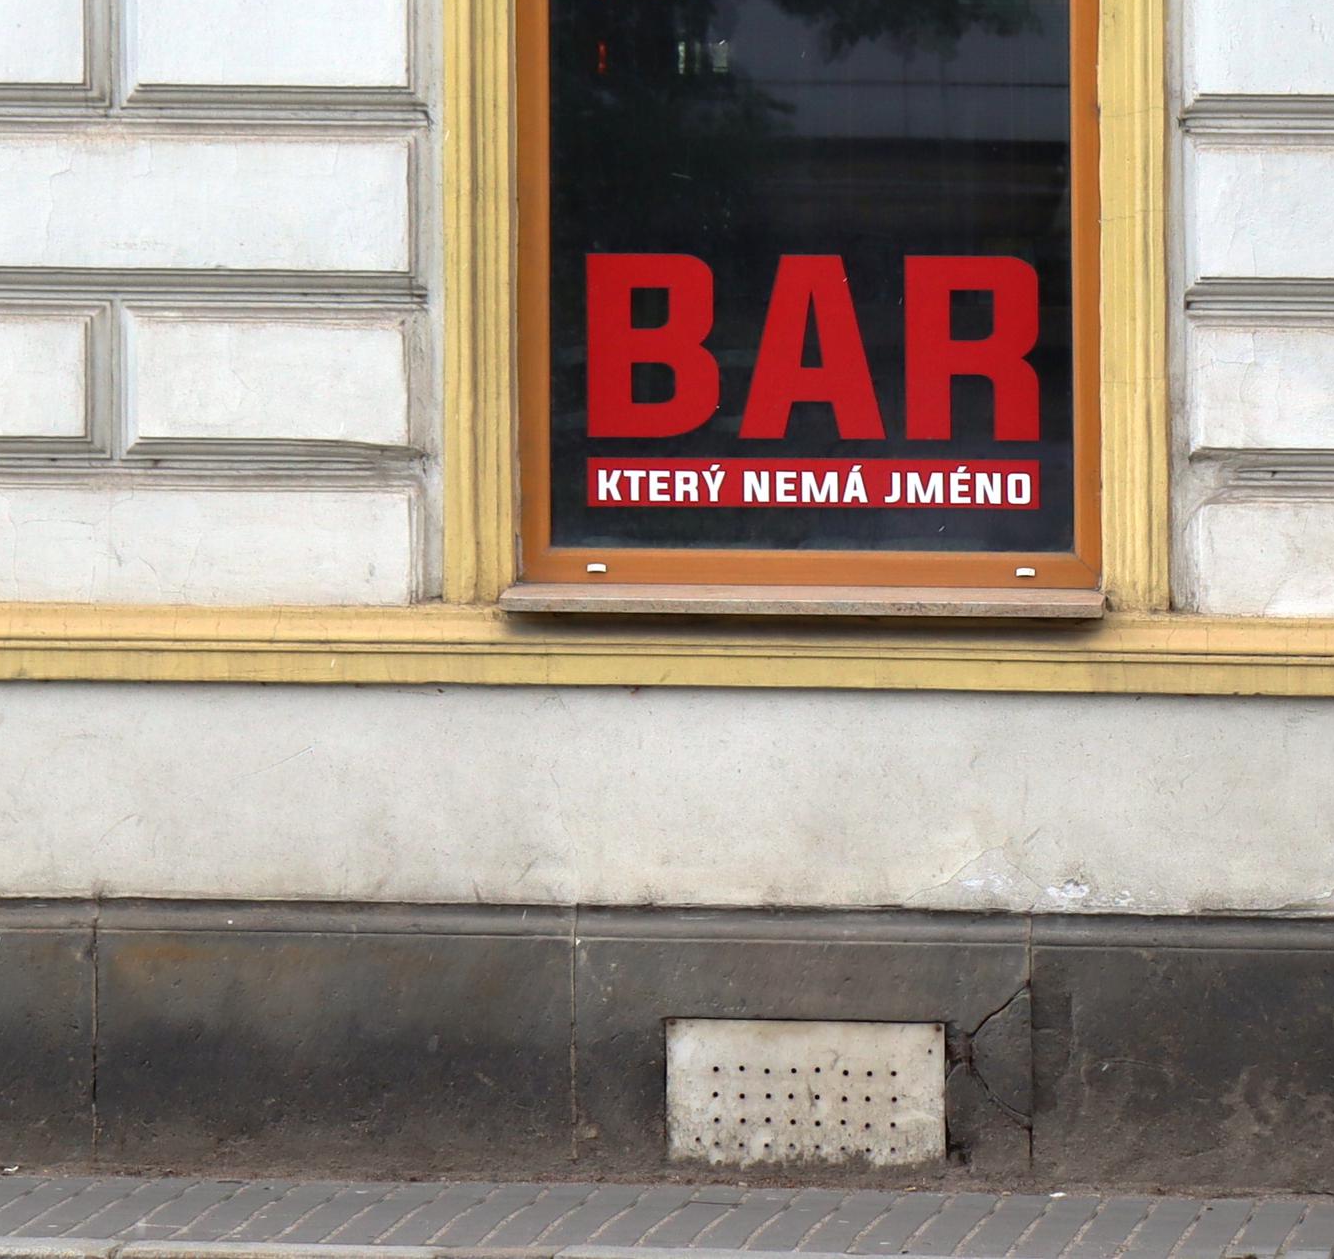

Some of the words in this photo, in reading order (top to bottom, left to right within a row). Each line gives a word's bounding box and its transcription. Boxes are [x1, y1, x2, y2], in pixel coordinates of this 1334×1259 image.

[586, 253, 1040, 440] BAR
[597, 464, 726, 502] KTERÝ
[743, 465, 868, 503] NEMÁ
[884, 466, 1032, 504] JMÉNO
